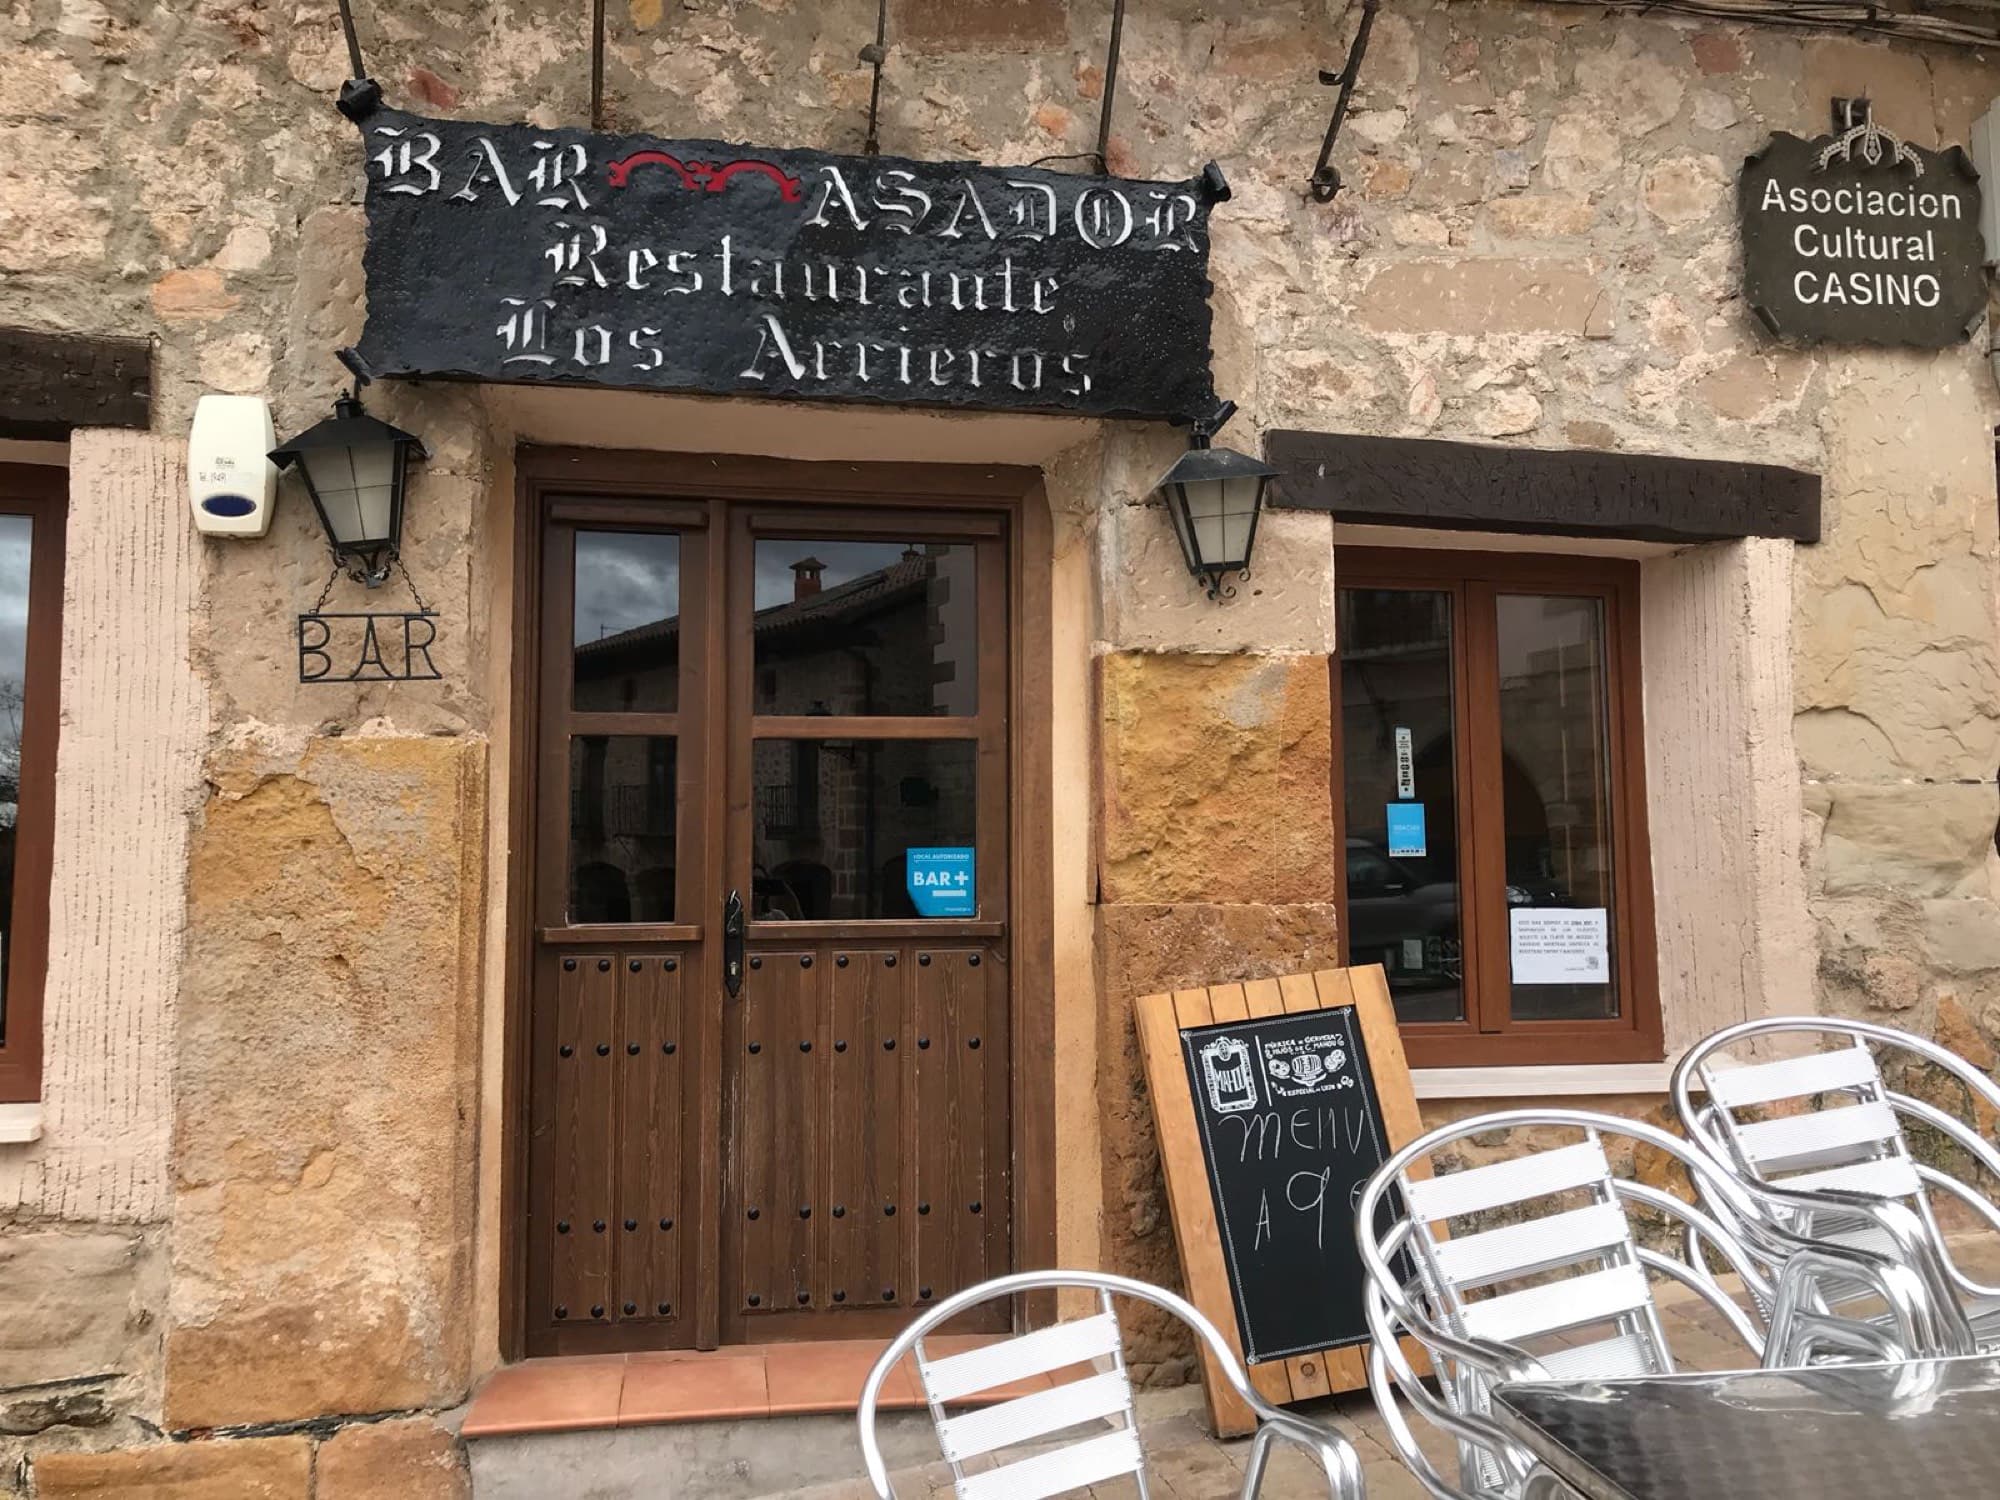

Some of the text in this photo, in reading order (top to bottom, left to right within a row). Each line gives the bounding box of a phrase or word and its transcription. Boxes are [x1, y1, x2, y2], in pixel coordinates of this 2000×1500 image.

[374, 127, 1198, 252] BAR ASADOR
[1761, 178, 1961, 219] Asociacion
[546, 222, 1058, 314] Restaurante
[1794, 223, 1935, 261] Cultural
[1793, 270, 1941, 307] CASINO
[496, 297, 1091, 396] Los Arrieros
[299, 614, 442, 682] BAR
